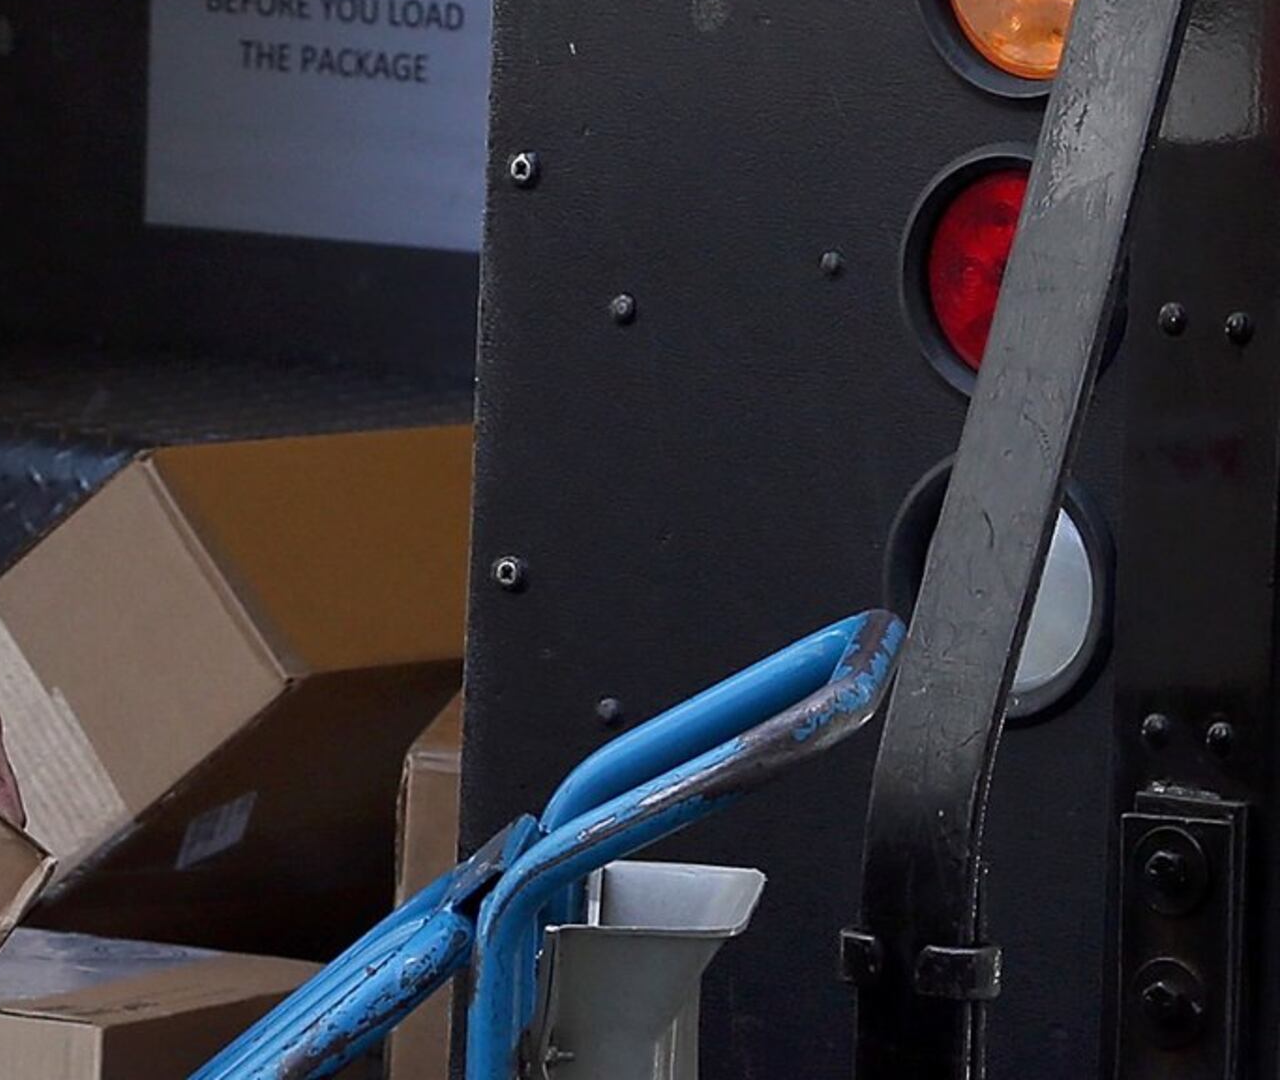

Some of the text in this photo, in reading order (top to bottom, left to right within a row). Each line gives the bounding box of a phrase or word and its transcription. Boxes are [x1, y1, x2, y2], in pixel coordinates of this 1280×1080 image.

[389, 0, 466, 32] LOAD
[239, 39, 430, 83] THE PACKAGE
